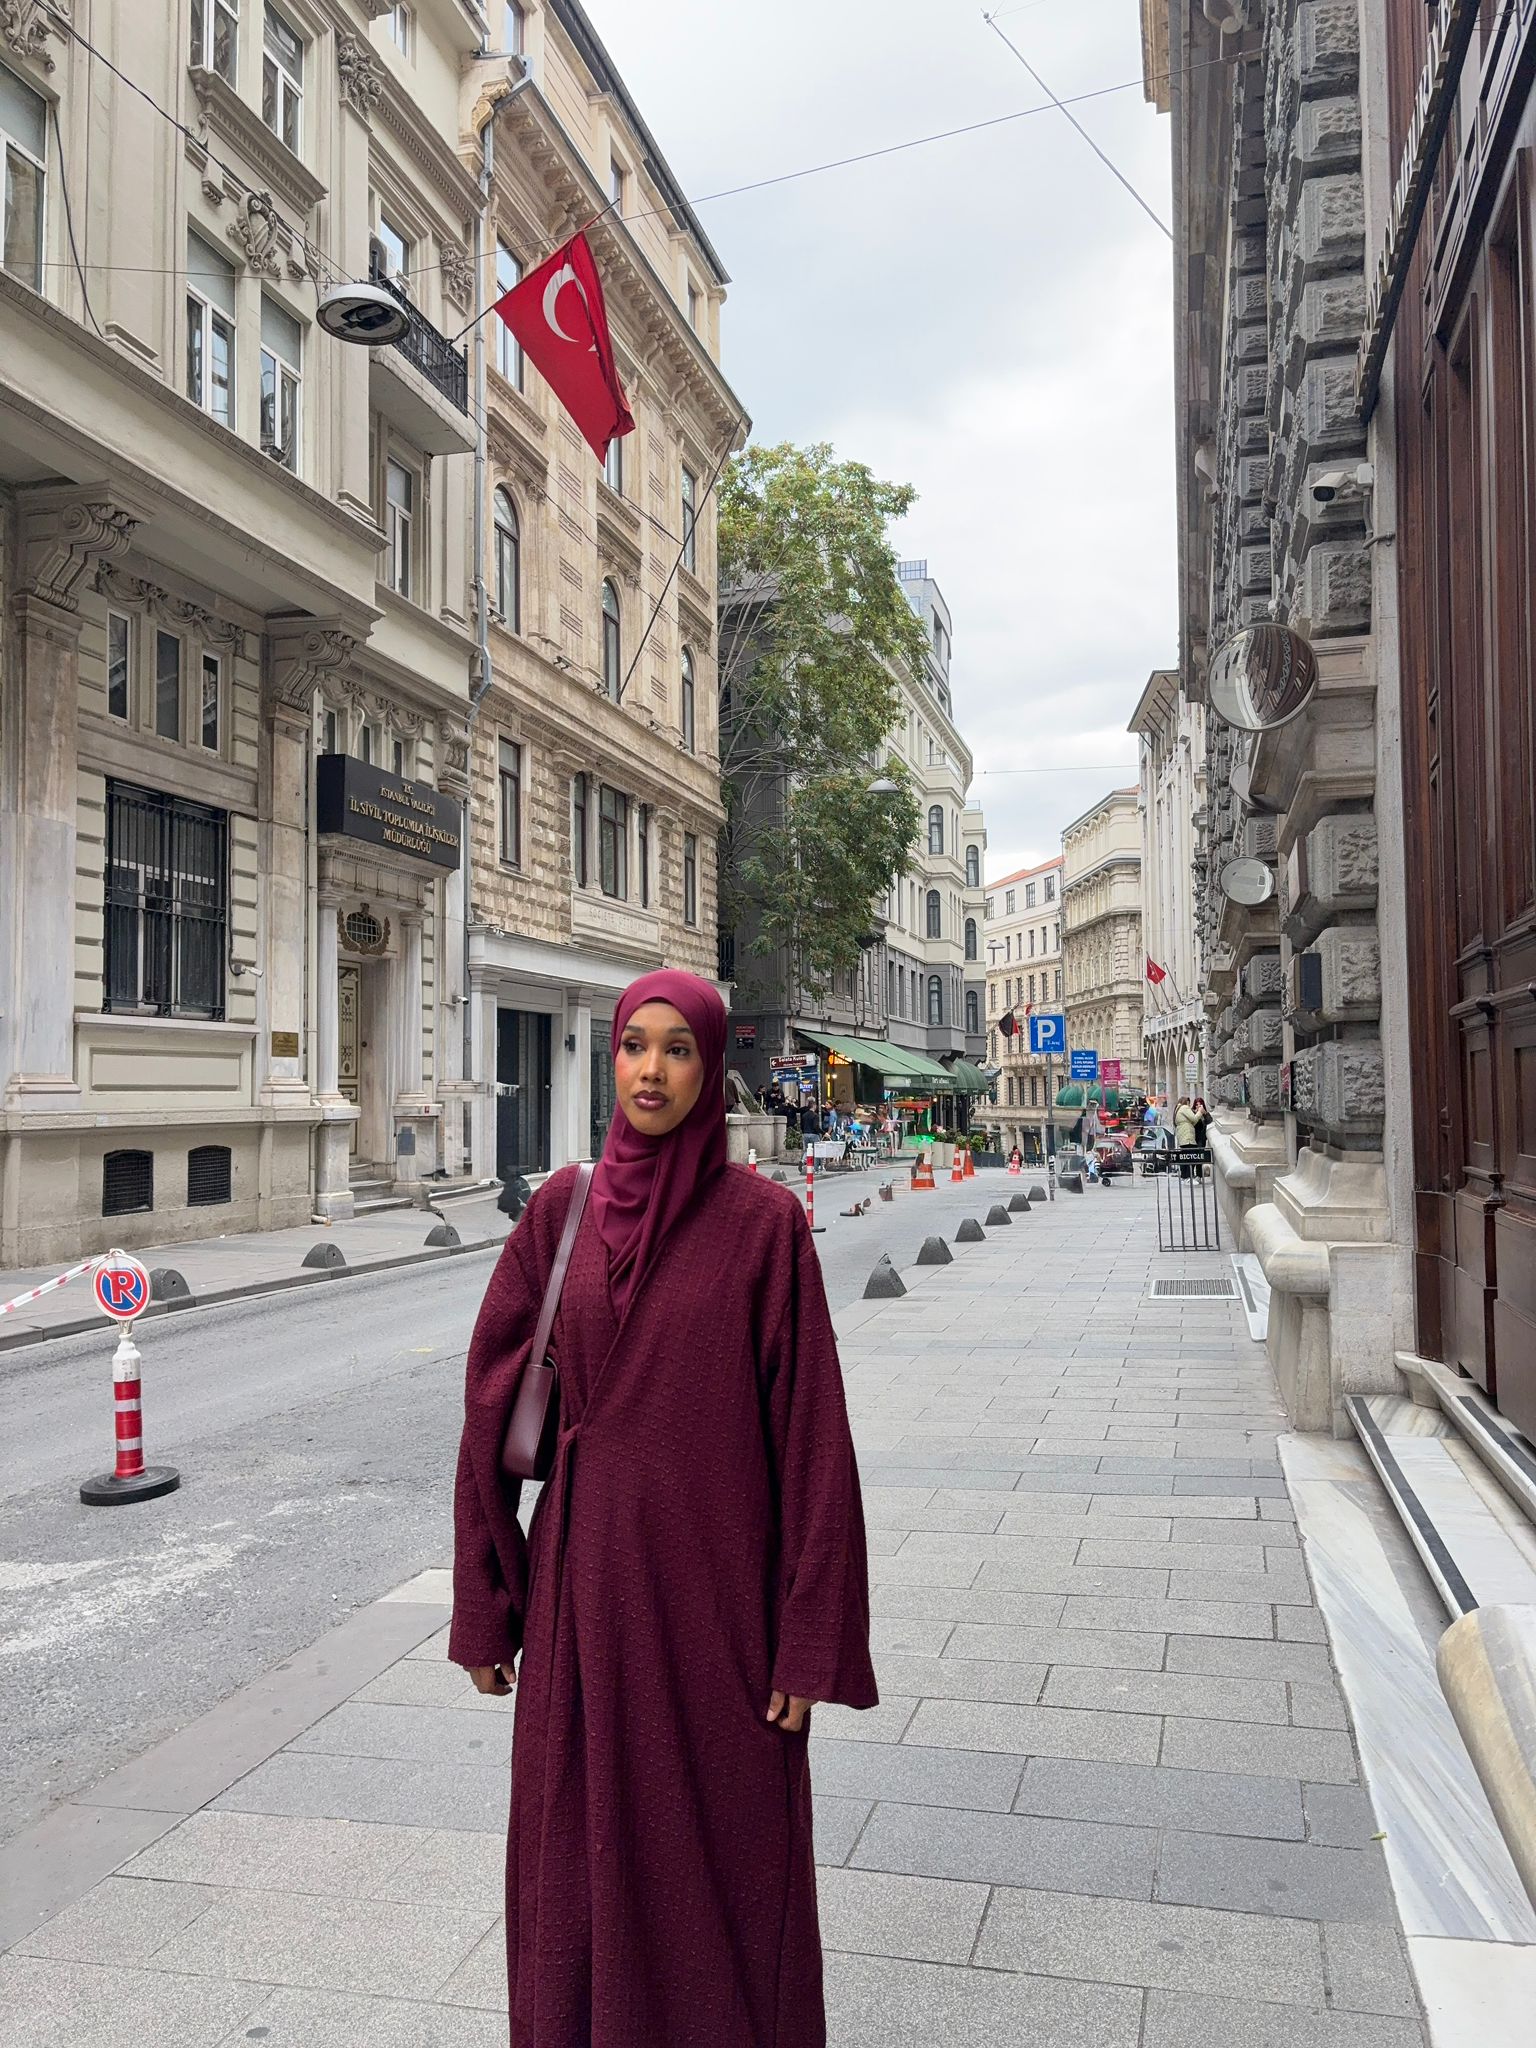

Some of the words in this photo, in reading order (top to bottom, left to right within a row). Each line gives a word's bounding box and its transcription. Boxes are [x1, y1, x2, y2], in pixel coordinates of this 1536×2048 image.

[381, 784, 410, 806] İSTANBUL
[350, 795, 360, 812] İL
[360, 800, 383, 821] SİVİL
[383, 810, 424, 835] TOPLUMLA
[424, 822, 459, 848] İLİŞKİLER
[383, 827, 433, 854] MÜDÜRLÜĞÜ
[1037, 1019, 1056, 1049] P
